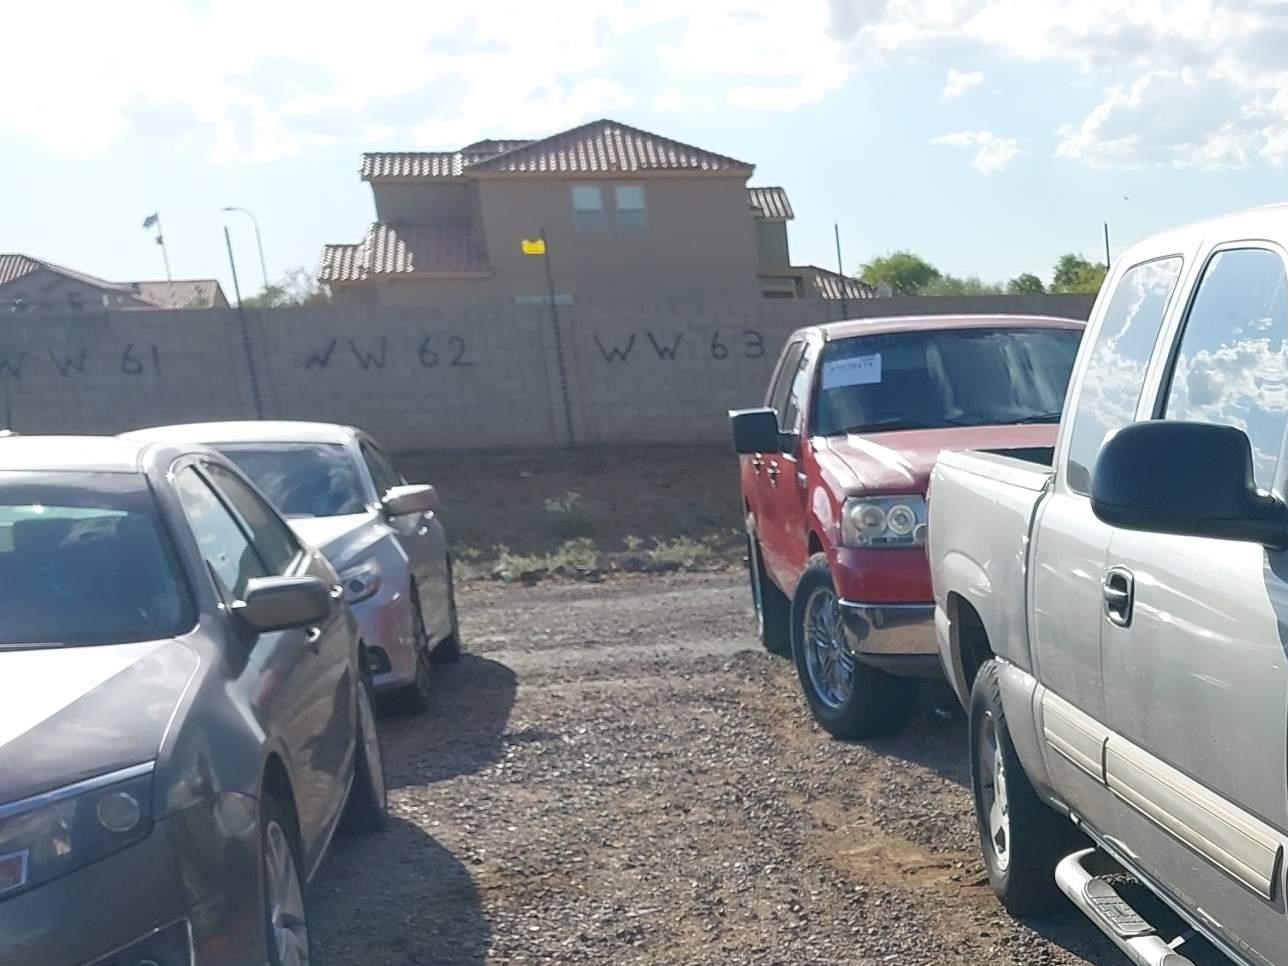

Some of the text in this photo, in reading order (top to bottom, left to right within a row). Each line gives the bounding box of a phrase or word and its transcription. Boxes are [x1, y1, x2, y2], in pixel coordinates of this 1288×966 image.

[121, 343, 163, 376] 61
[418, 335, 476, 369] 62
[710, 329, 766, 360] 63
